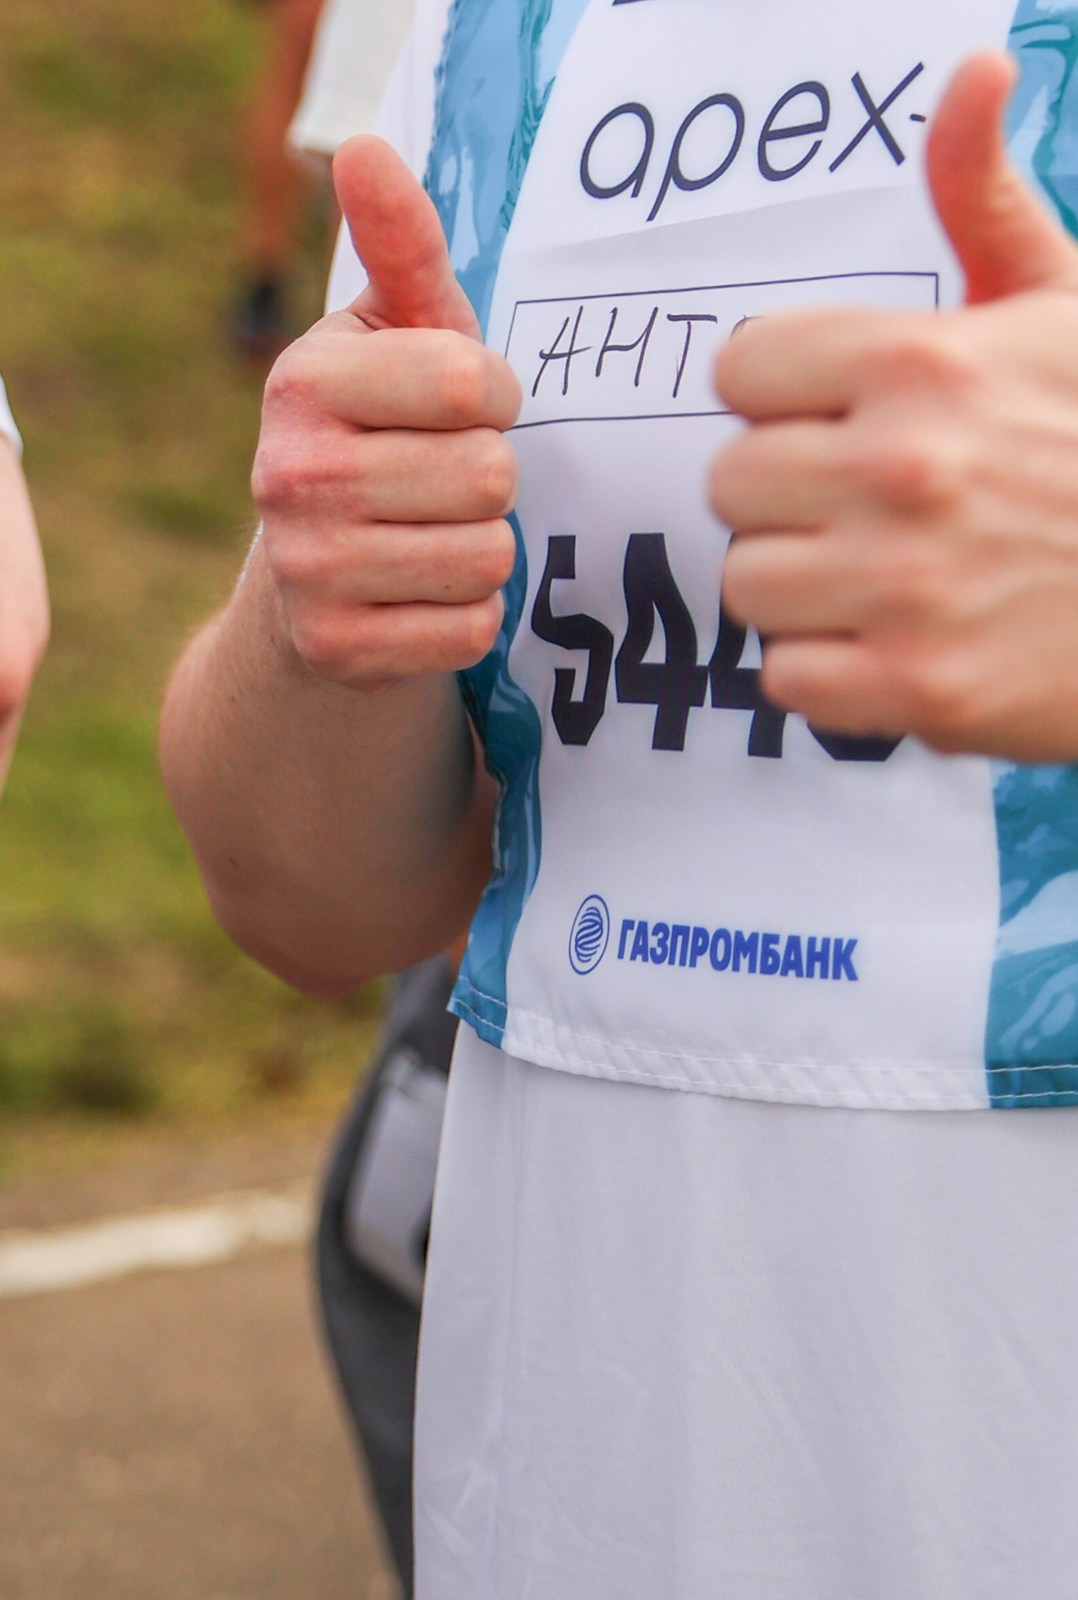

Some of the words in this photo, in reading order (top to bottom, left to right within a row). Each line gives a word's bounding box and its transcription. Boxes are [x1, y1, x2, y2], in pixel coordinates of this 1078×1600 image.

[531, 304, 762, 398] АНТ
[531, 533, 908, 762] 544
[617, 918, 859, 982] ГАЗПРОМБАНК
